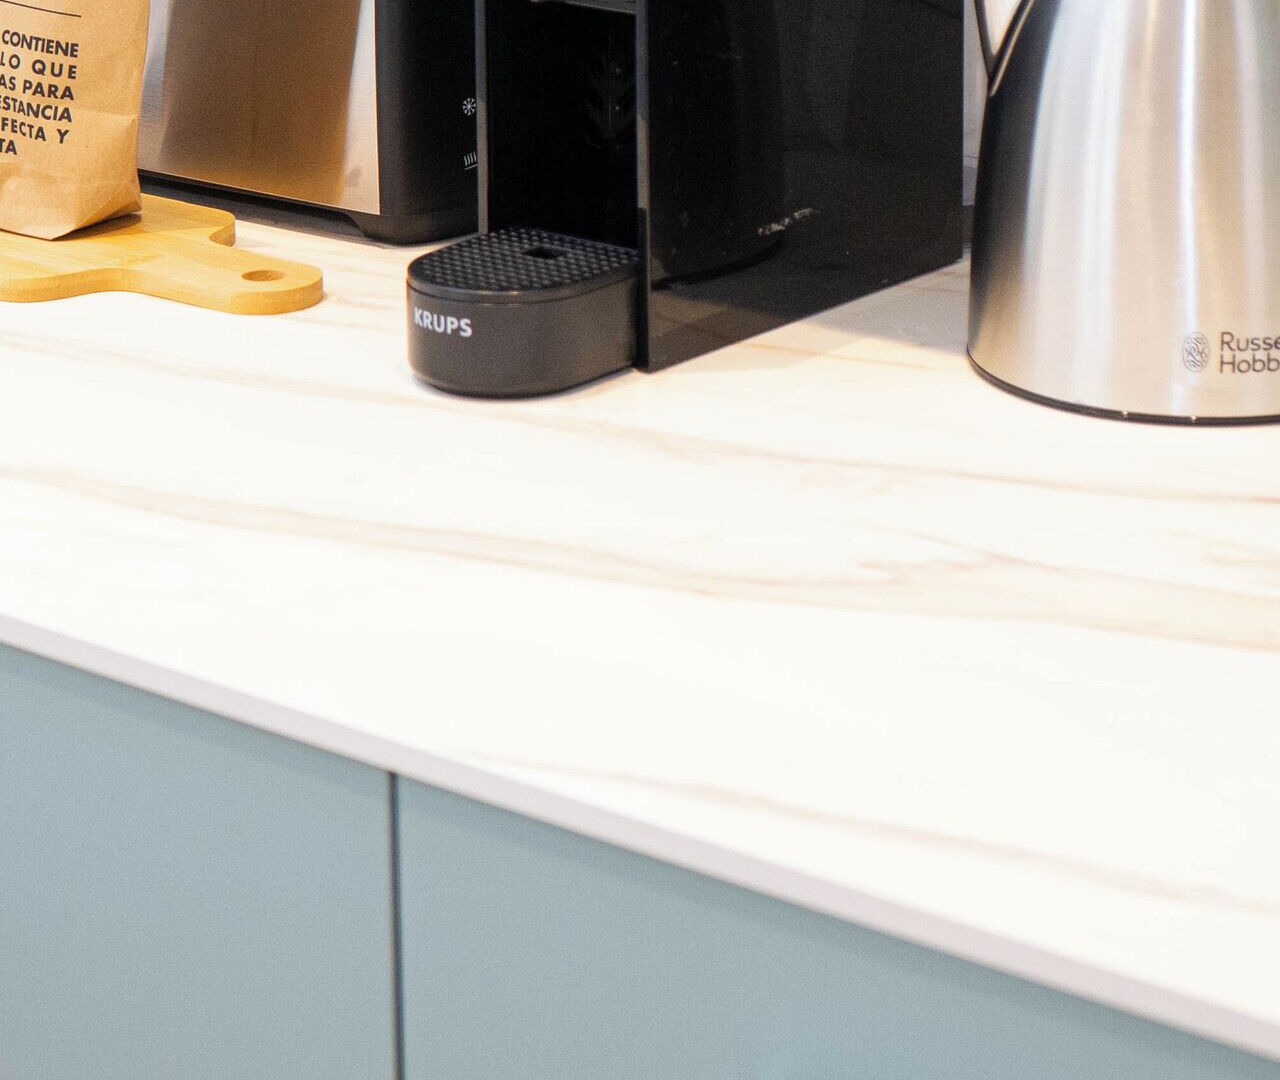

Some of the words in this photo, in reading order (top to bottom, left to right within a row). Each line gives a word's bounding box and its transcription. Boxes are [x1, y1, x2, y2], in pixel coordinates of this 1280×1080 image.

[2, 30, 79, 58] CONTIENE
[0, 51, 20, 70] LO
[31, 59, 77, 80] QUE
[23, 79, 74, 101] PARA
[56, 128, 70, 144] Y
[414, 306, 472, 337] KRUPS
